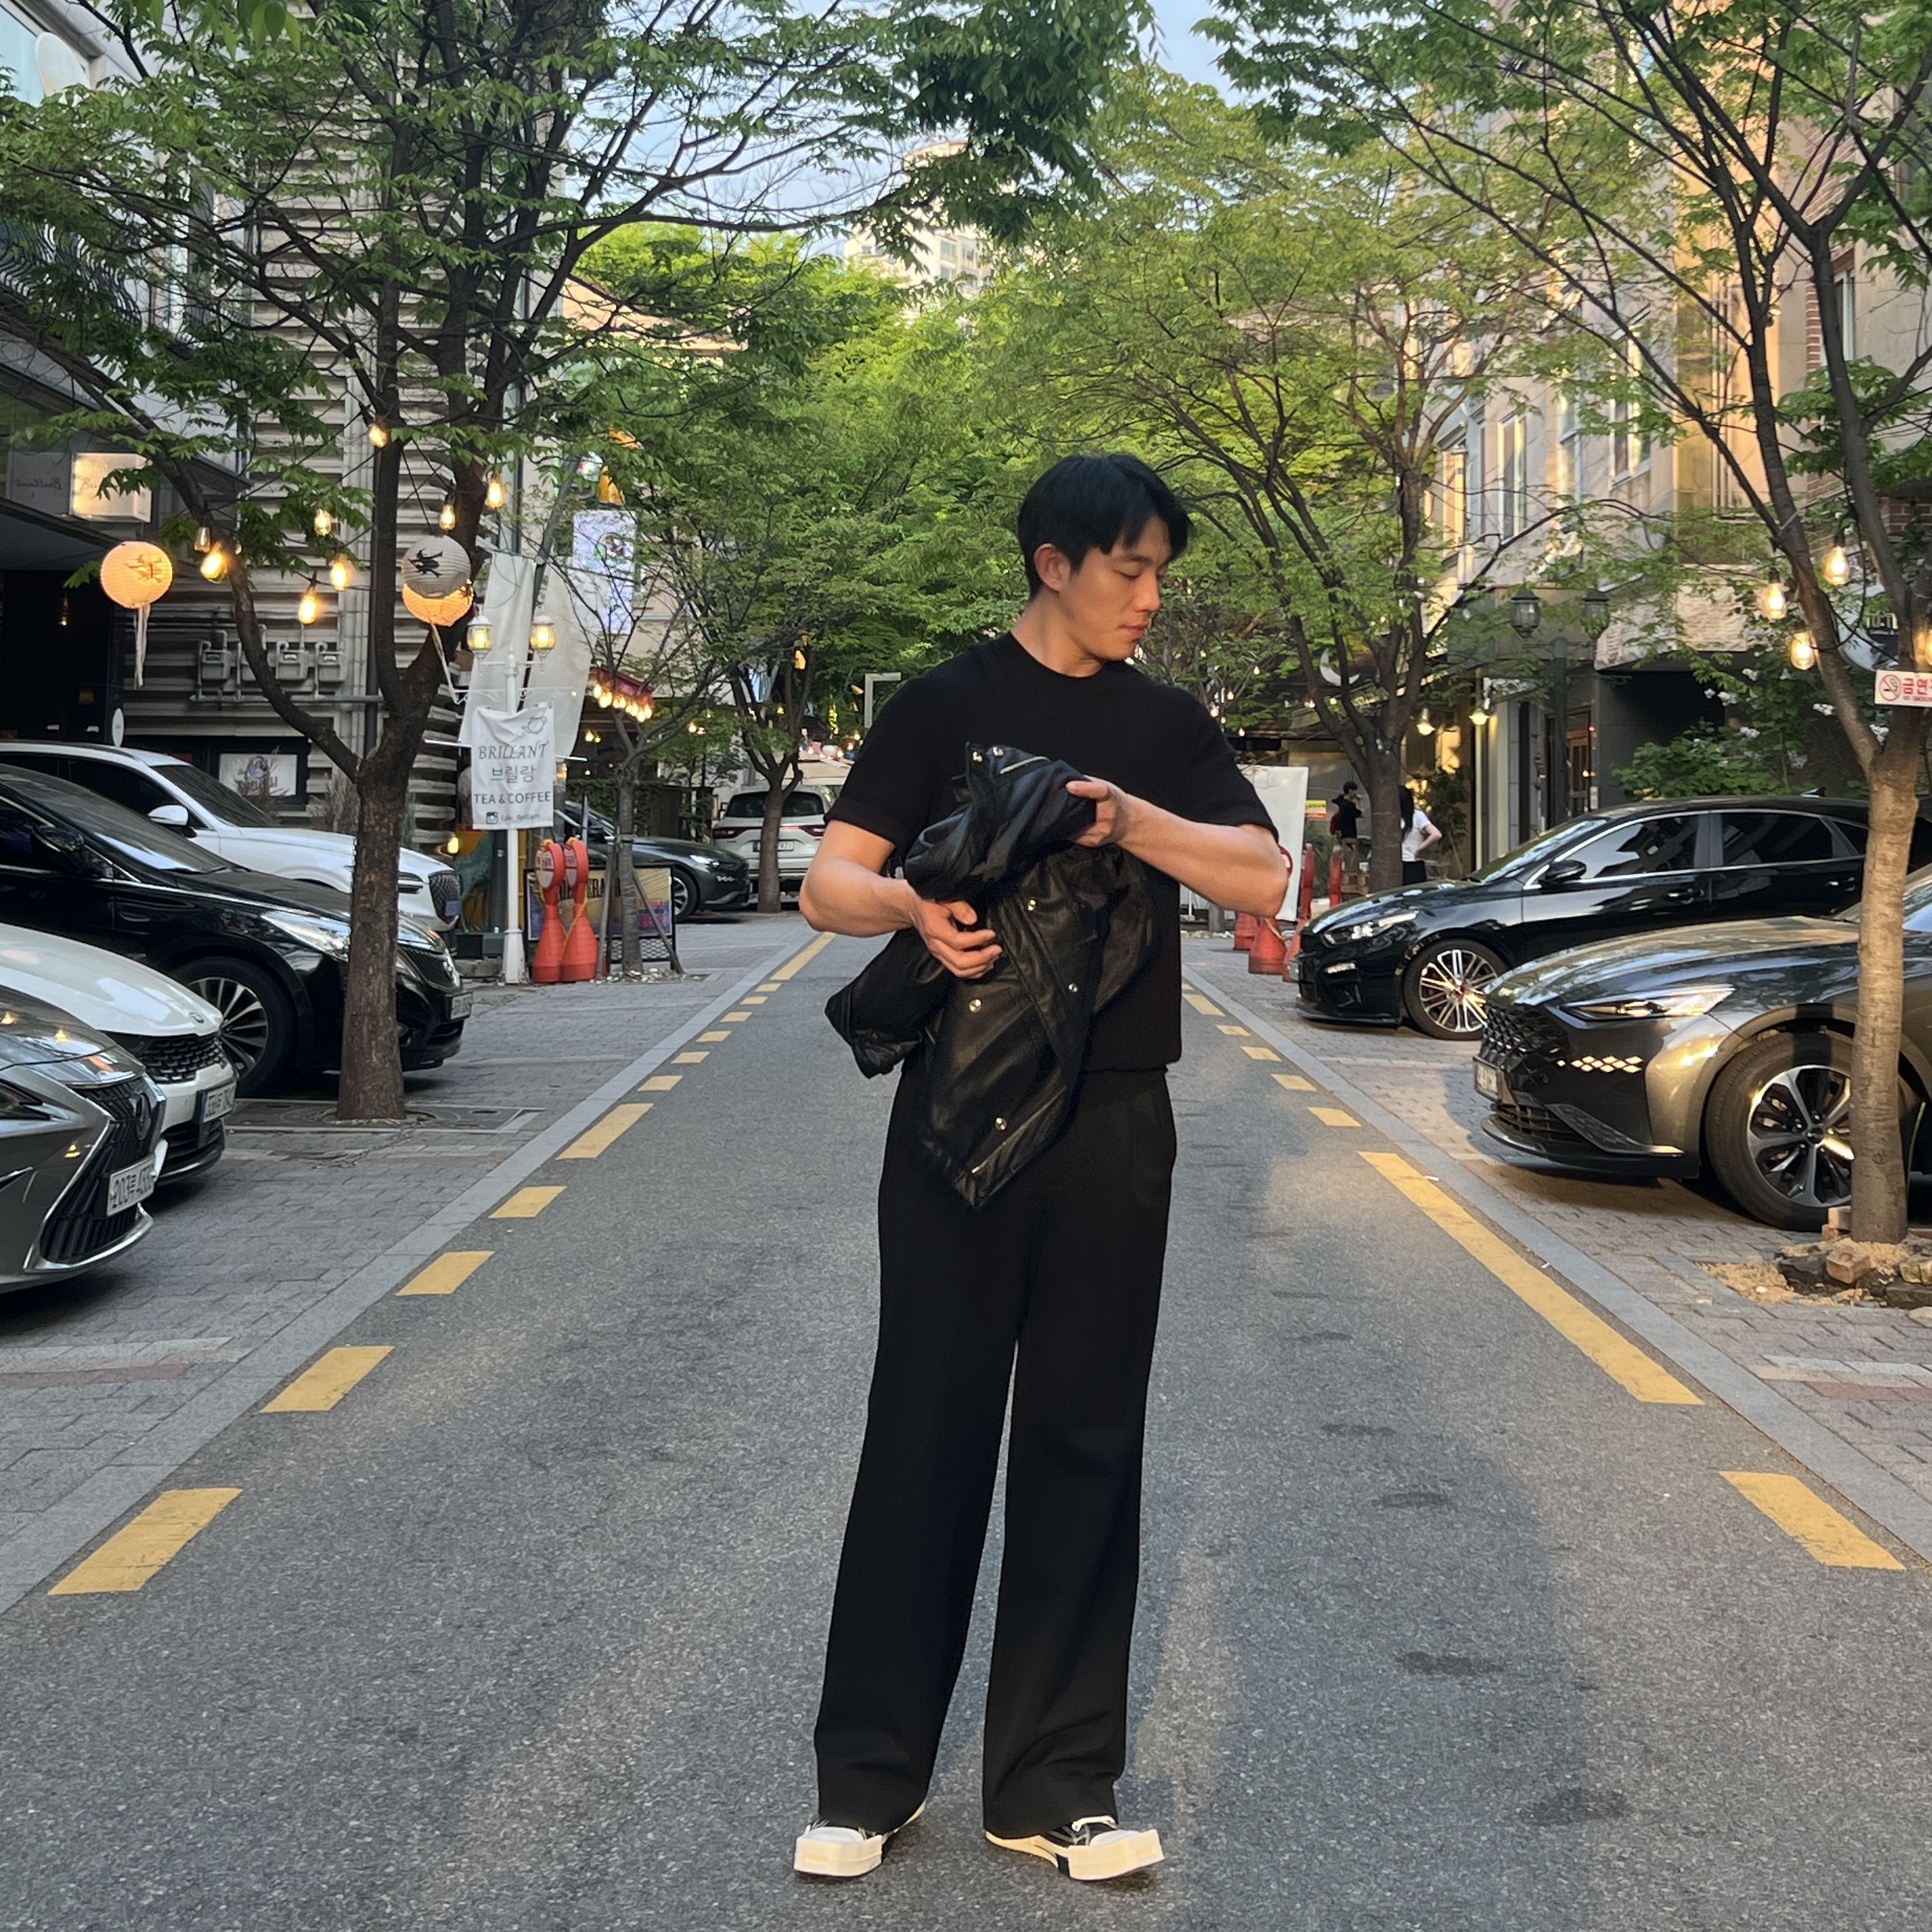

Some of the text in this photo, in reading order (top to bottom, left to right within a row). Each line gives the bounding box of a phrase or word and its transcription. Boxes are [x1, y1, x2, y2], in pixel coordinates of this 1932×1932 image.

[478, 740, 550, 760] BRILLANT
[491, 765, 536, 784] 브릴랑
[474, 793, 496, 805] TEA
[507, 790, 551, 804] COFFEE
